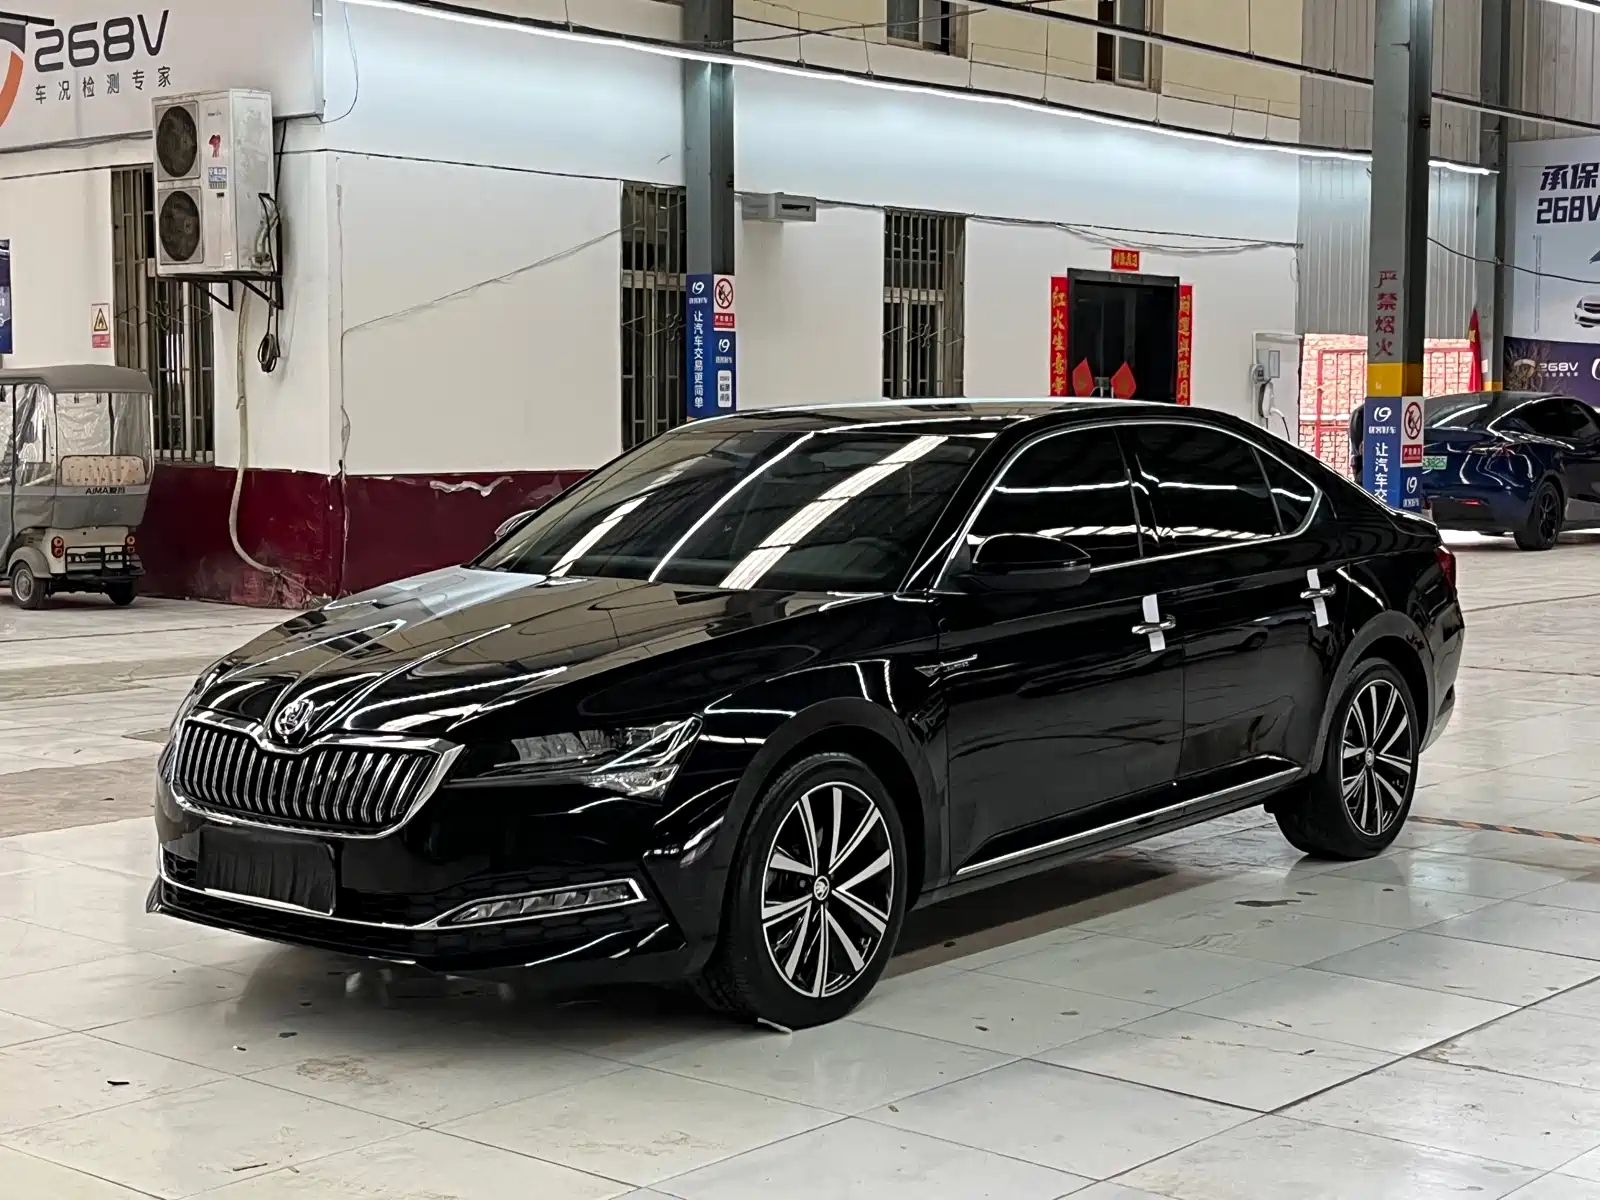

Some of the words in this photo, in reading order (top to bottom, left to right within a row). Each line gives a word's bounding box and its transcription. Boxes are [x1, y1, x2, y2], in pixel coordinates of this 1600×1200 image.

[35, 10, 169, 72] 268V
[35, 66, 171, 104] 车况检测专家
[1540, 163, 1600, 191] 承保
[1536, 195, 1600, 224] 268V
[1374, 271, 1398, 357] 严禁烟火
